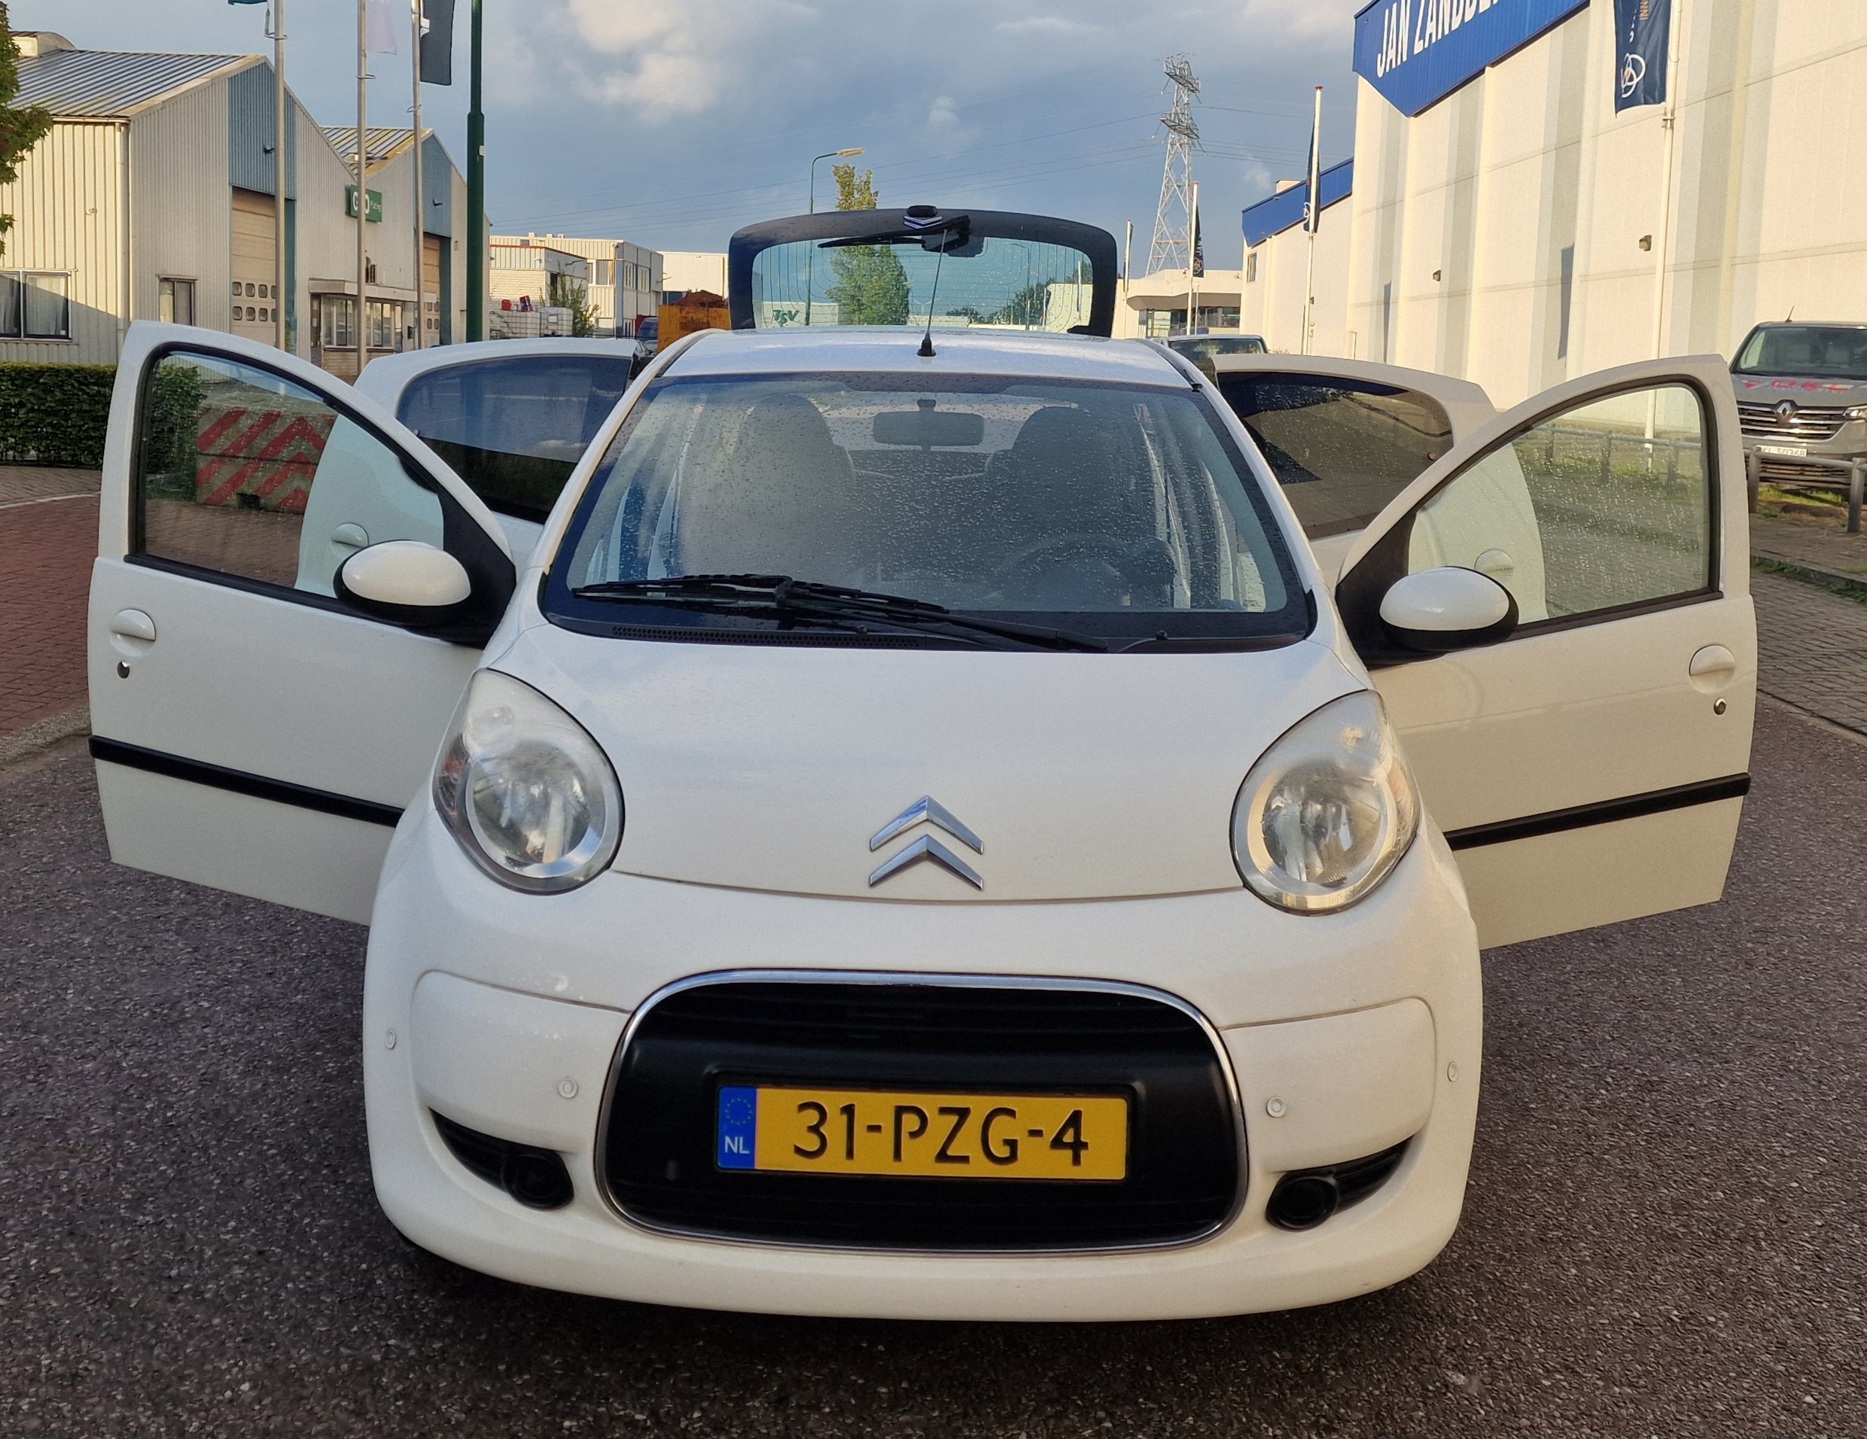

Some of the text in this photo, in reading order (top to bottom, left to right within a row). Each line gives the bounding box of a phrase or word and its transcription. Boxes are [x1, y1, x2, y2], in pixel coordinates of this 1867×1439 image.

[1638, 0, 1649, 21] INN
[1376, 0, 1411, 78] JAN
[352, 191, 370, 214] GO
[724, 1135, 751, 1155] NL
[793, 1101, 1090, 1167] 31-PZG-4
